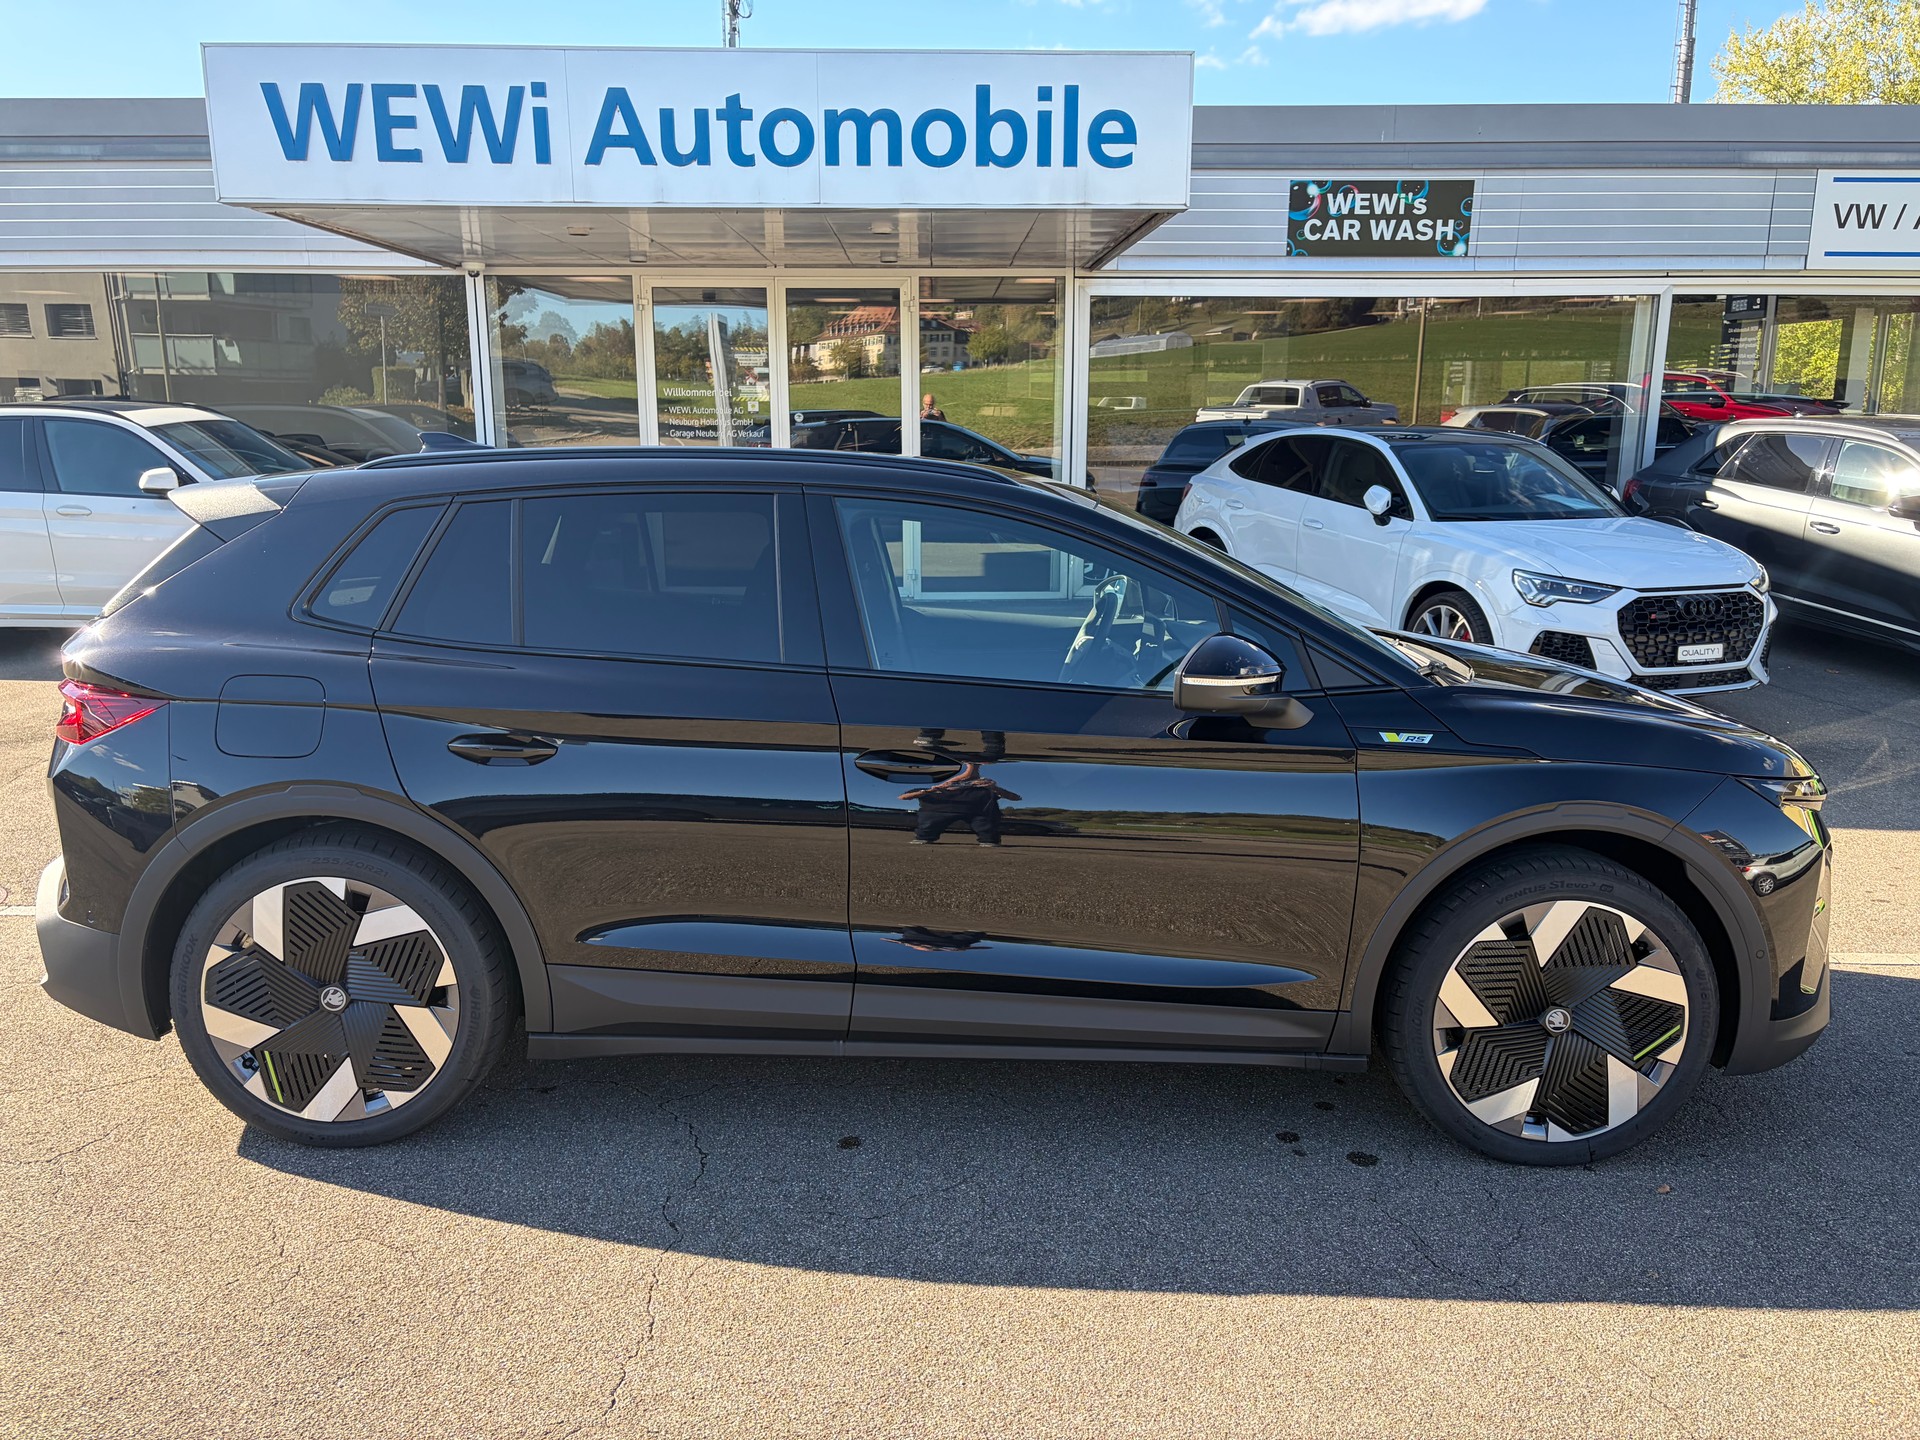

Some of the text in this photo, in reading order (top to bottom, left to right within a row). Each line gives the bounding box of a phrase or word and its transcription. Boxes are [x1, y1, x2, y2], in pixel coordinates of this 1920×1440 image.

[259, 81, 1138, 169] WEWi Automobile
[1326, 192, 1428, 215] WEWi's
[1833, 204, 1888, 230] VW
[1303, 219, 1456, 241] CAR WASH
[663, 388, 717, 397] Willkommen
[668, 406, 692, 414] WEWi
[733, 407, 744, 415] AG
[670, 418, 699, 427] Neuburg
[731, 418, 753, 426] GmbH
[670, 430, 695, 439] Garage
[726, 430, 737, 438] AG
[738, 430, 765, 438] Verkauf
[1681, 648, 1716, 657] QUALITY
